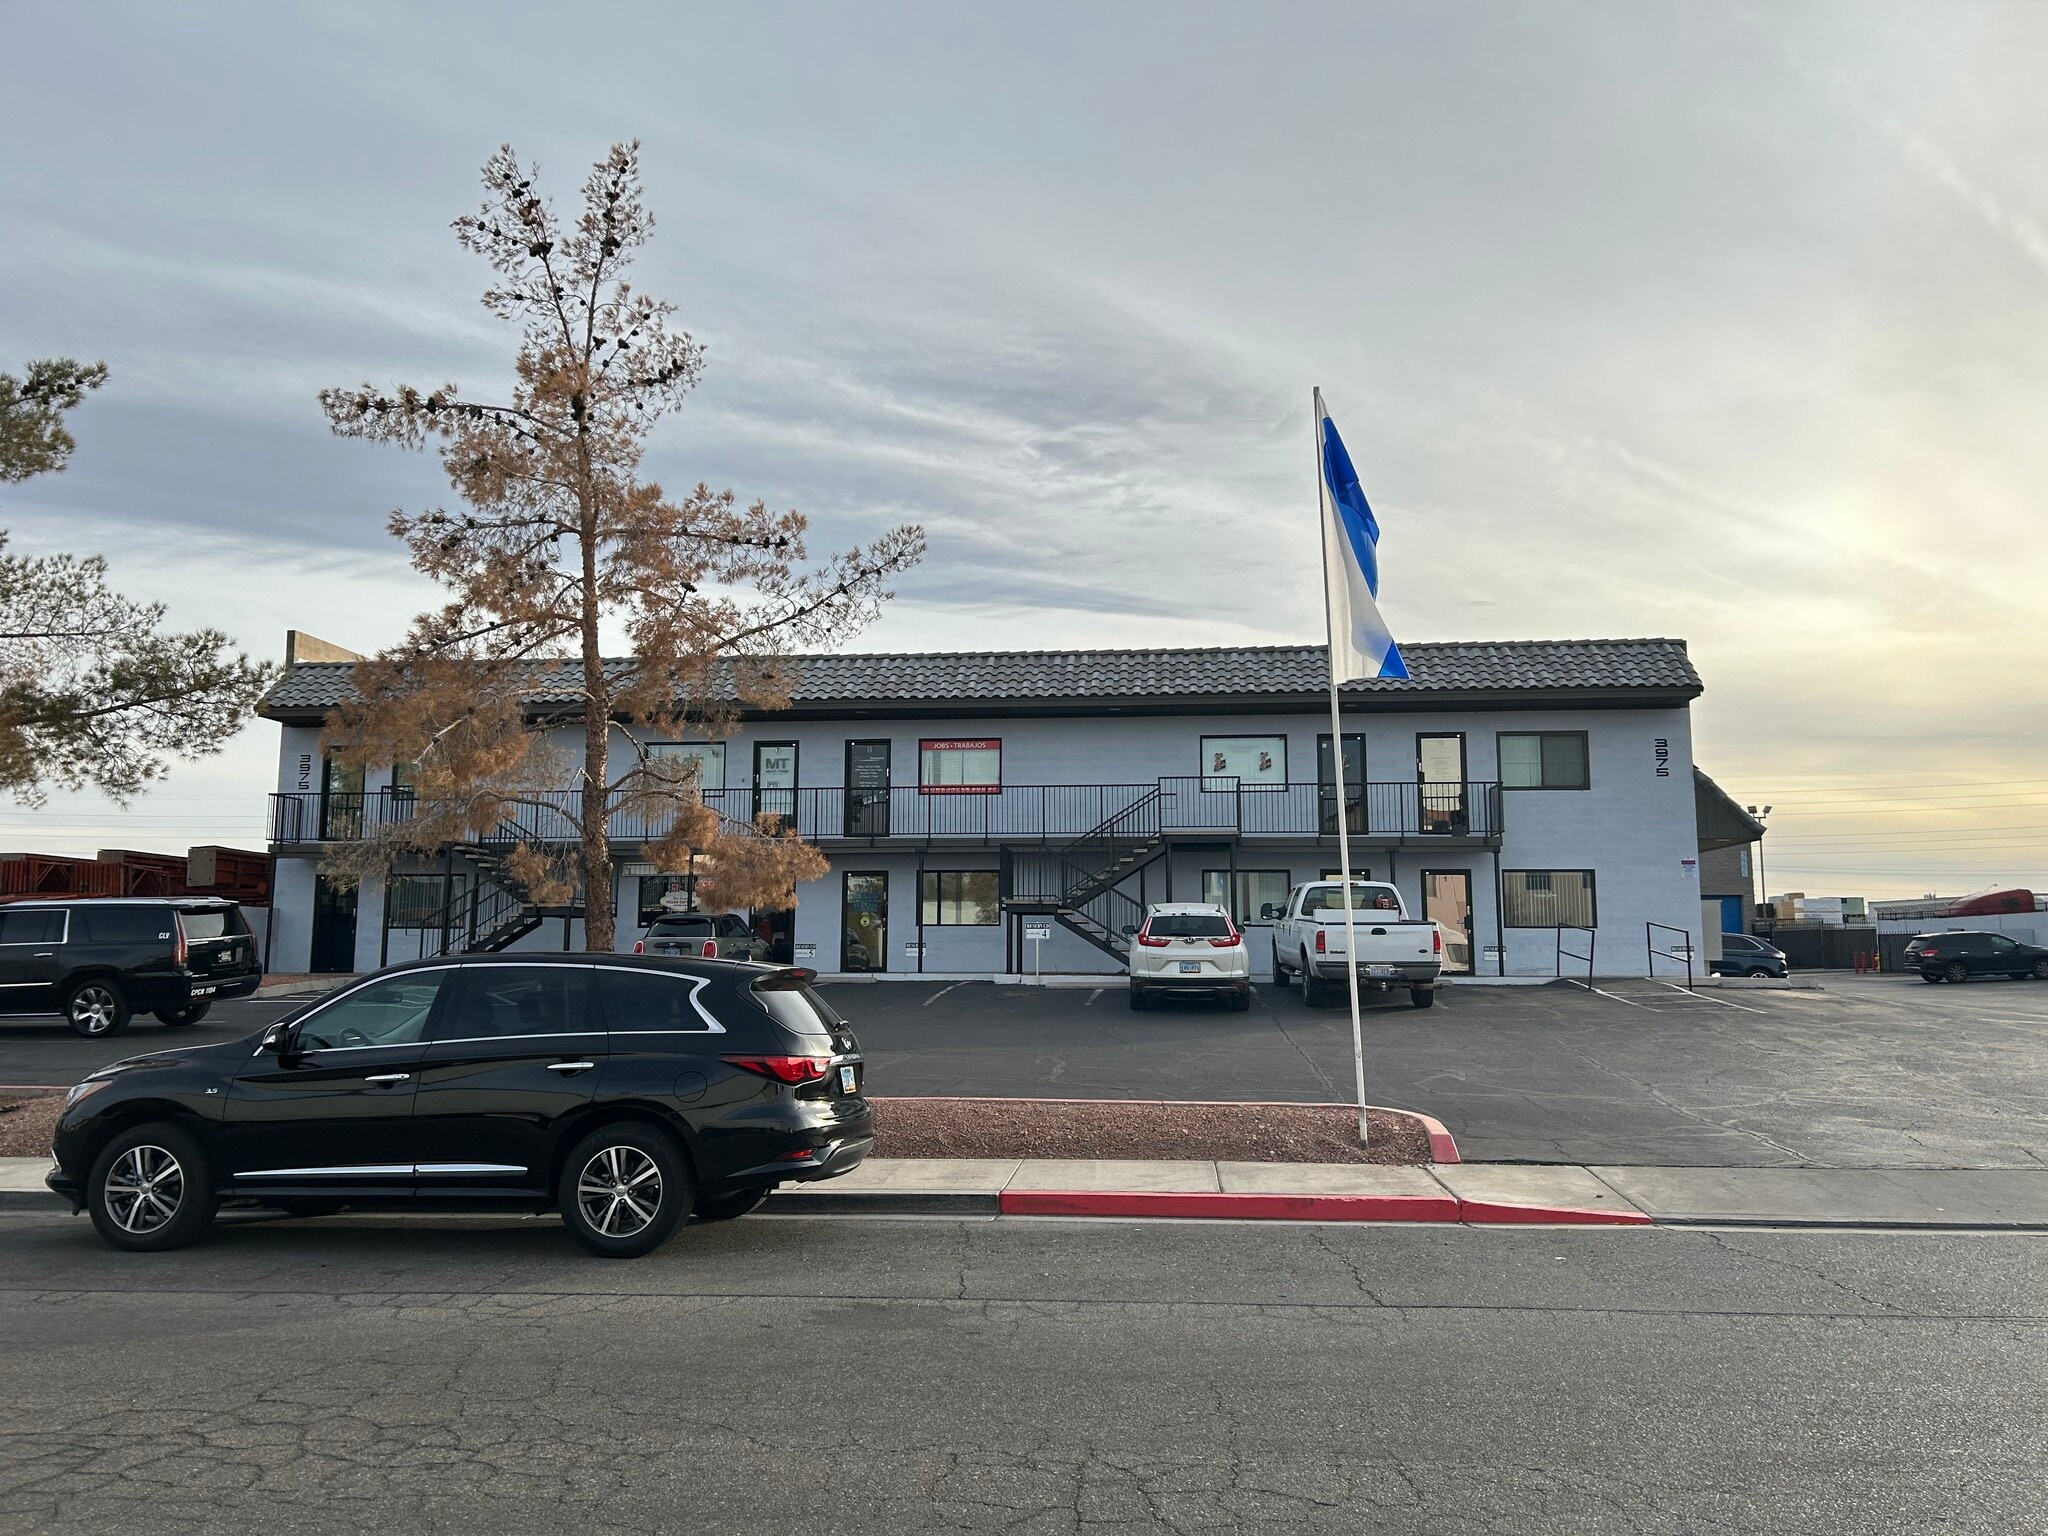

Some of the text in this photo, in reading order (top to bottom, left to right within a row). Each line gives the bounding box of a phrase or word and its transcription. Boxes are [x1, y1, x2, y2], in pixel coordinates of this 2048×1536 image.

[1654, 738, 1669, 777] 3975
[765, 758, 790, 769] MT
[298, 754, 311, 790] 3975
[1041, 929, 1047, 938] 4
[808, 949, 814, 958] 5
